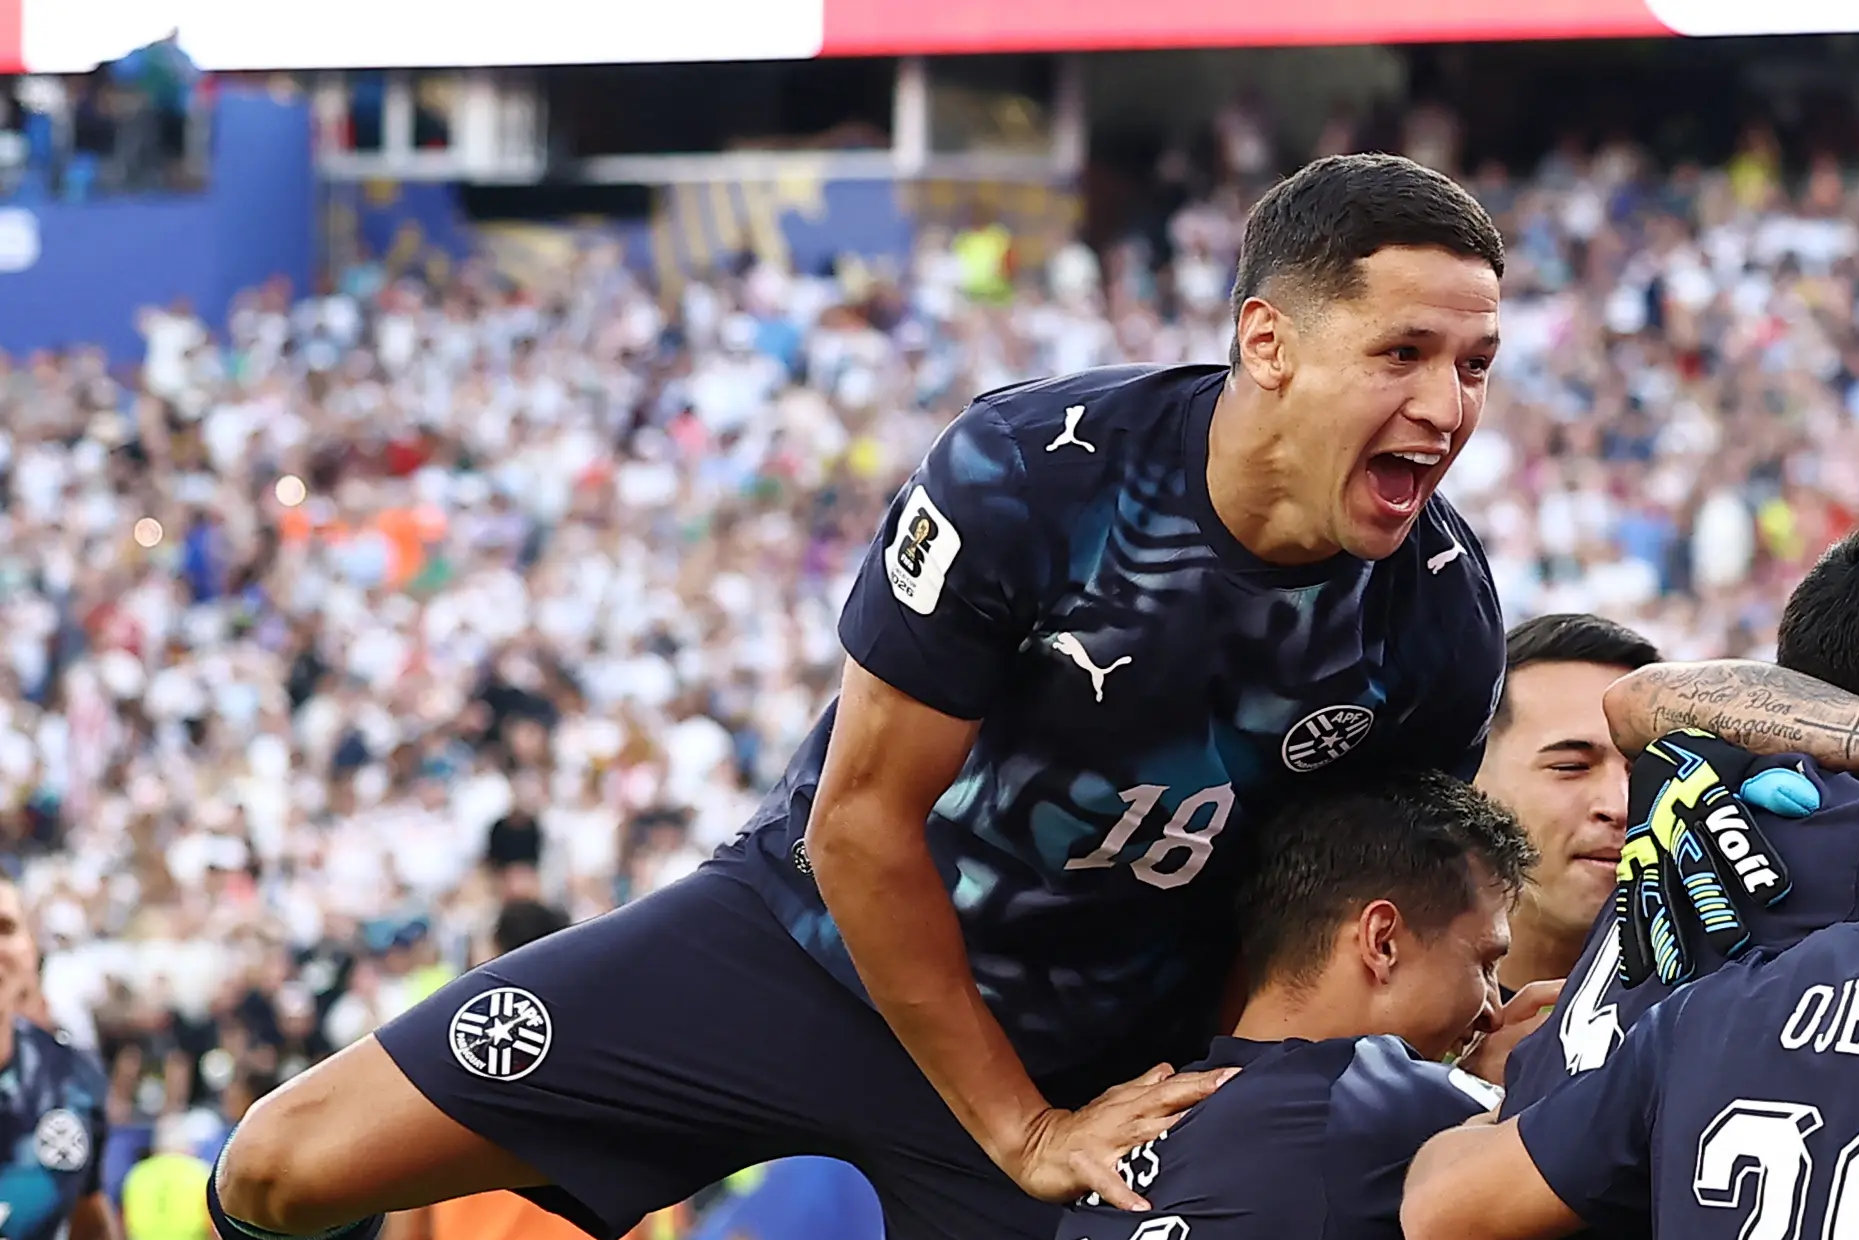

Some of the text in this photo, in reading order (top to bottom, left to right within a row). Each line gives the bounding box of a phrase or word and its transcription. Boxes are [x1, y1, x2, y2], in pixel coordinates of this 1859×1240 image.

[891, 571, 914, 598] 026
[1331, 711, 1363, 723] APF
[1064, 781, 1236, 890] 18
[1705, 804, 1780, 893] Voit
[513, 1000, 543, 1026] APF
